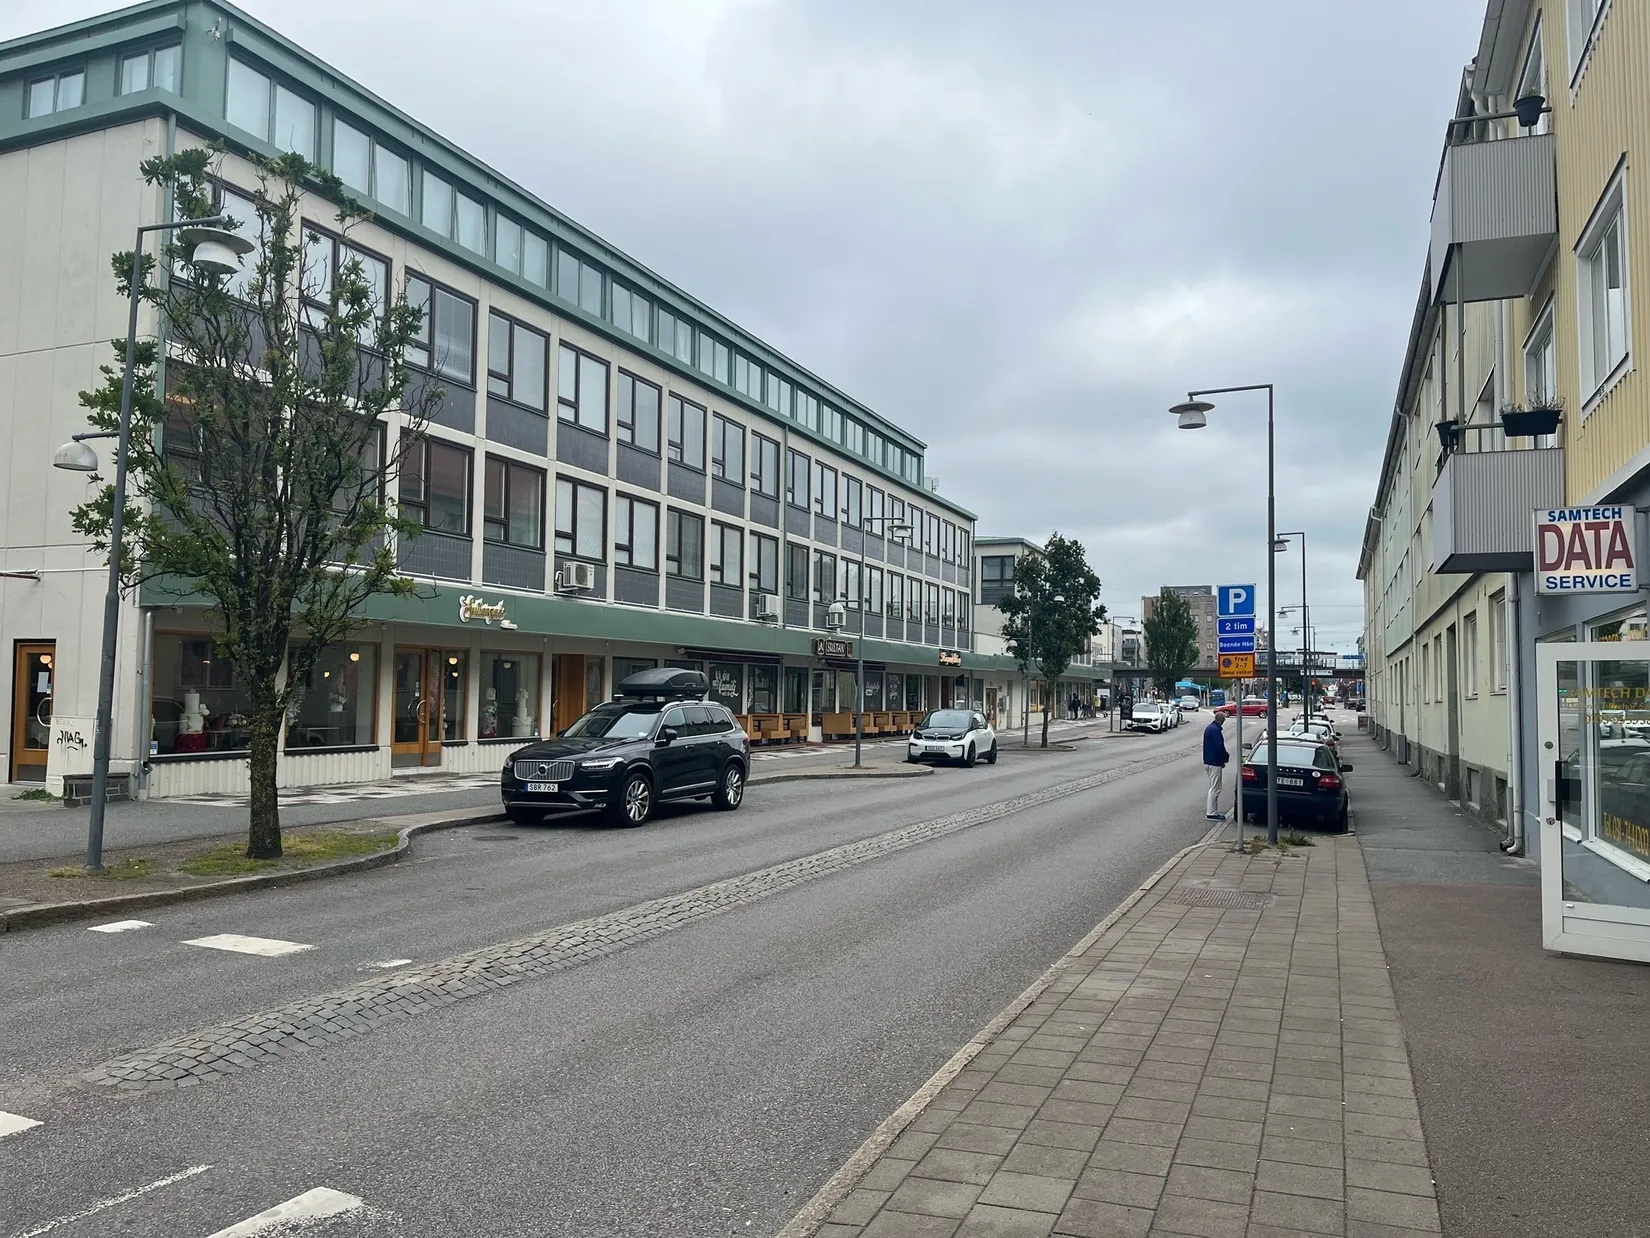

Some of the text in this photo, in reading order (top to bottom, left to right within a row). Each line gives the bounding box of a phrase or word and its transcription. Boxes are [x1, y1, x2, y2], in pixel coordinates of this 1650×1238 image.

[1548, 507, 1622, 522] SAMTECH
[1538, 521, 1634, 571] DATA
[1546, 574, 1632, 589] SERVICE
[1229, 588, 1247, 614] P
[1225, 622, 1248, 630] 2 tim
[529, 783, 542, 791] SBR
